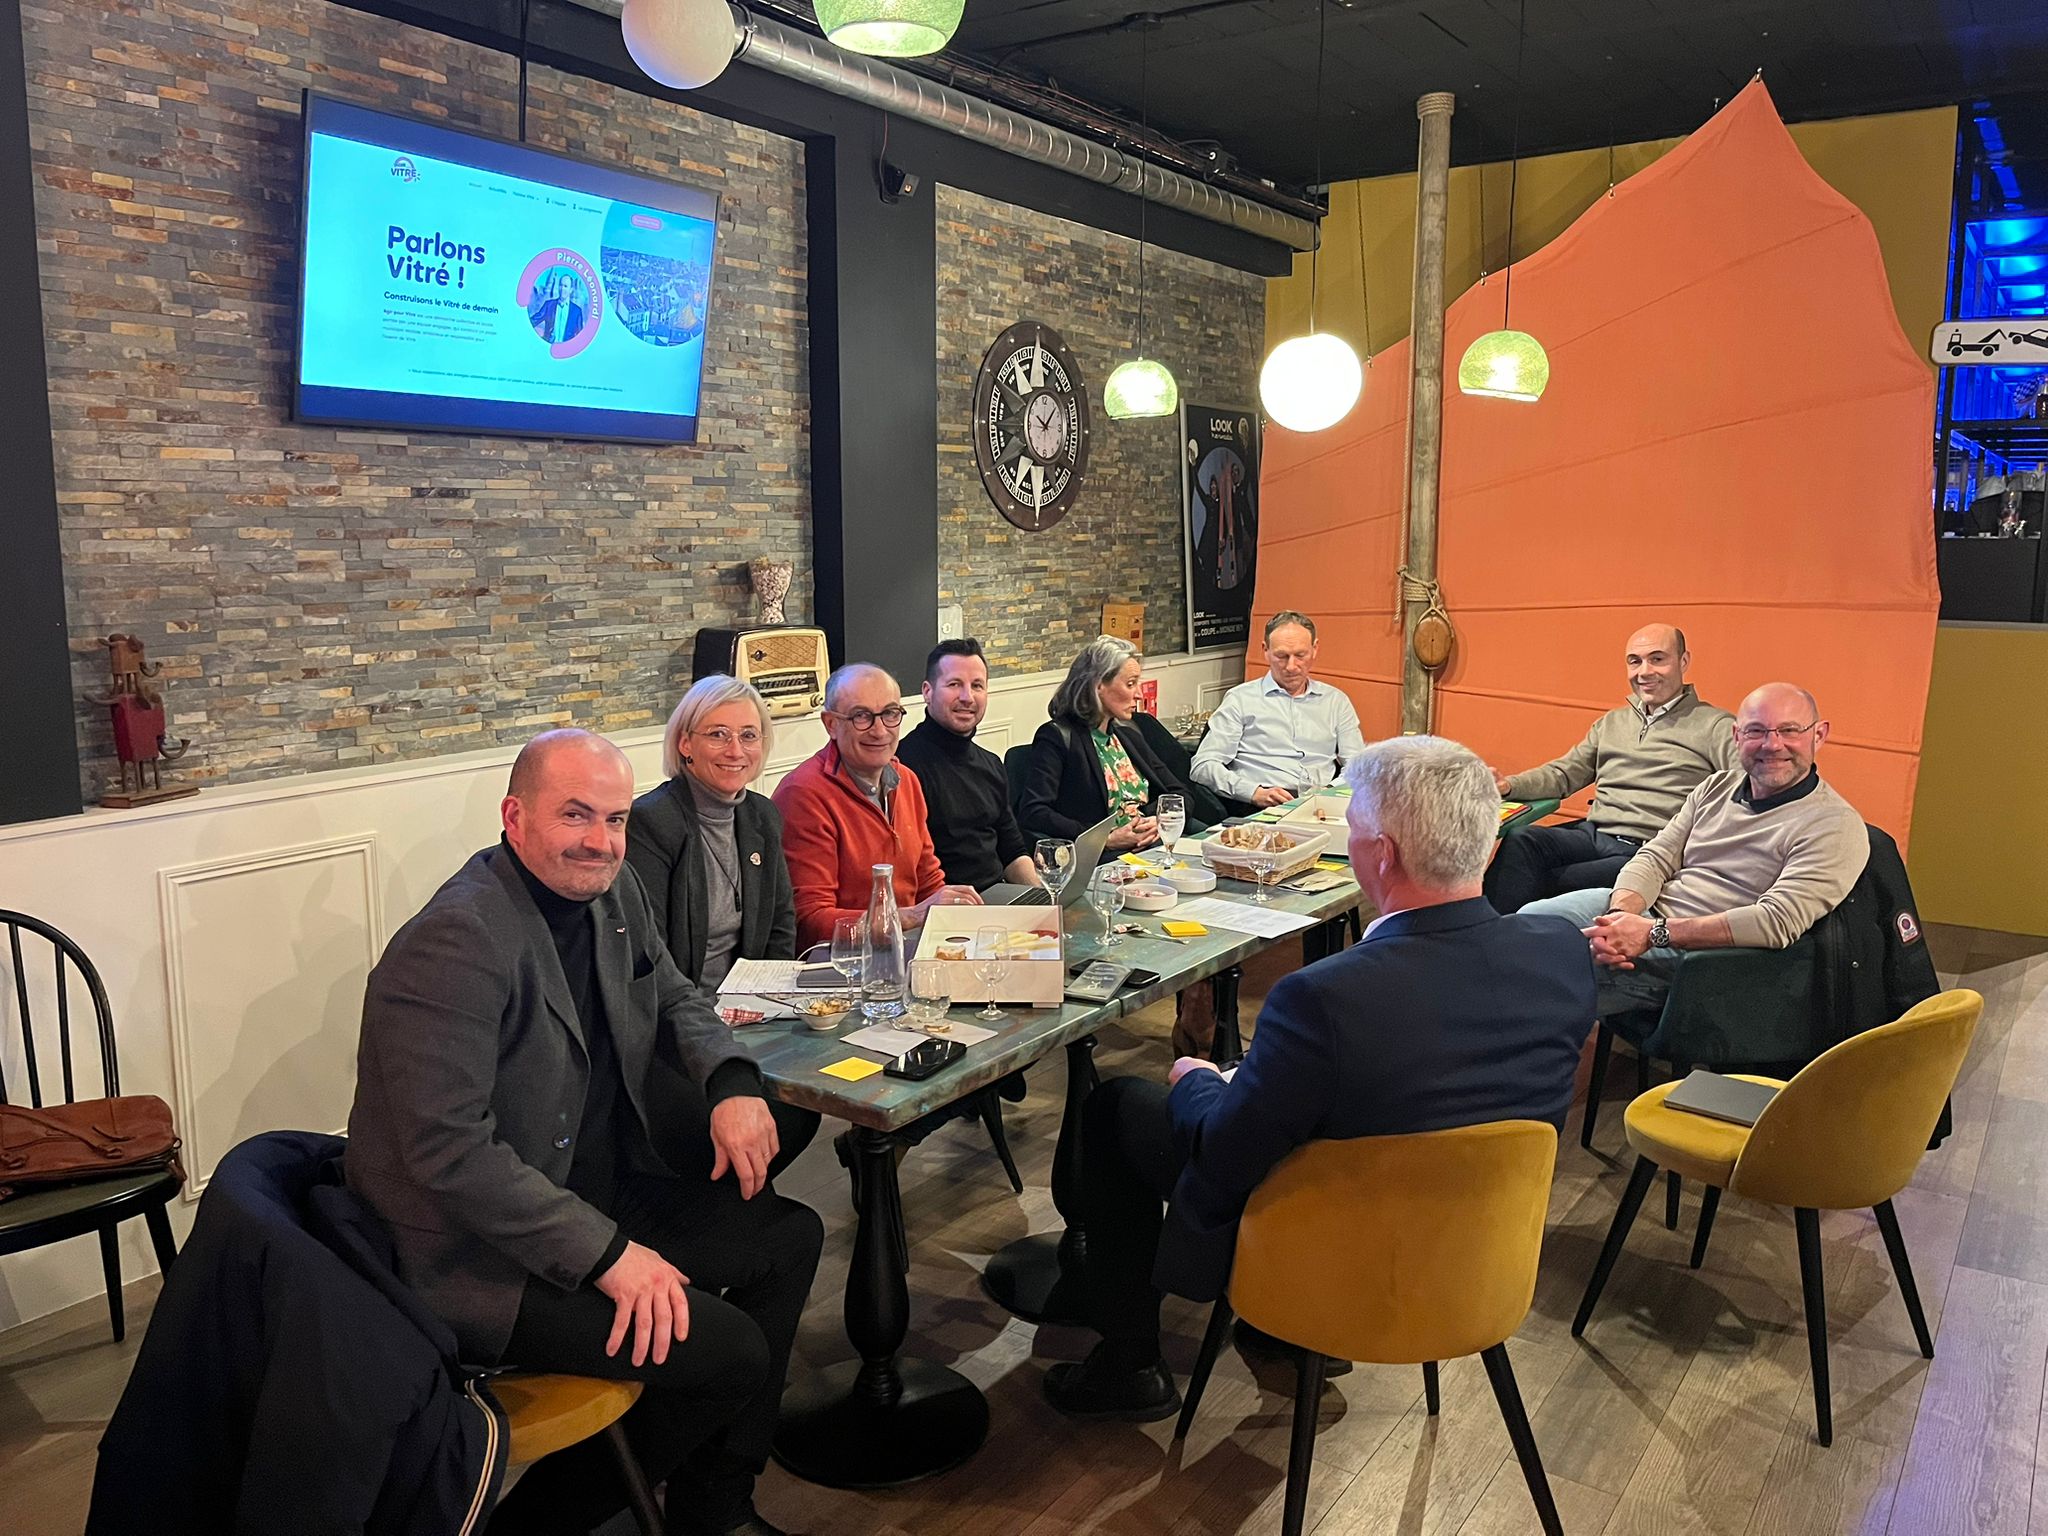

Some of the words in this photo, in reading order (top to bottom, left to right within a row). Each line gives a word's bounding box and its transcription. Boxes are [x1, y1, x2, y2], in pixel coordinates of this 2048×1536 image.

[387, 225, 485, 264] Parlons
[386, 254, 450, 286] Vitré
[457, 266, 465, 289] !
[556, 252, 584, 271] Pierre
[383, 291, 434, 305] Construisons
[434, 298, 442, 306] le
[443, 299, 460, 309] Vitré
[461, 302, 471, 310] de
[472, 303, 499, 314] demain
[1210, 418, 1233, 433] LOOK
